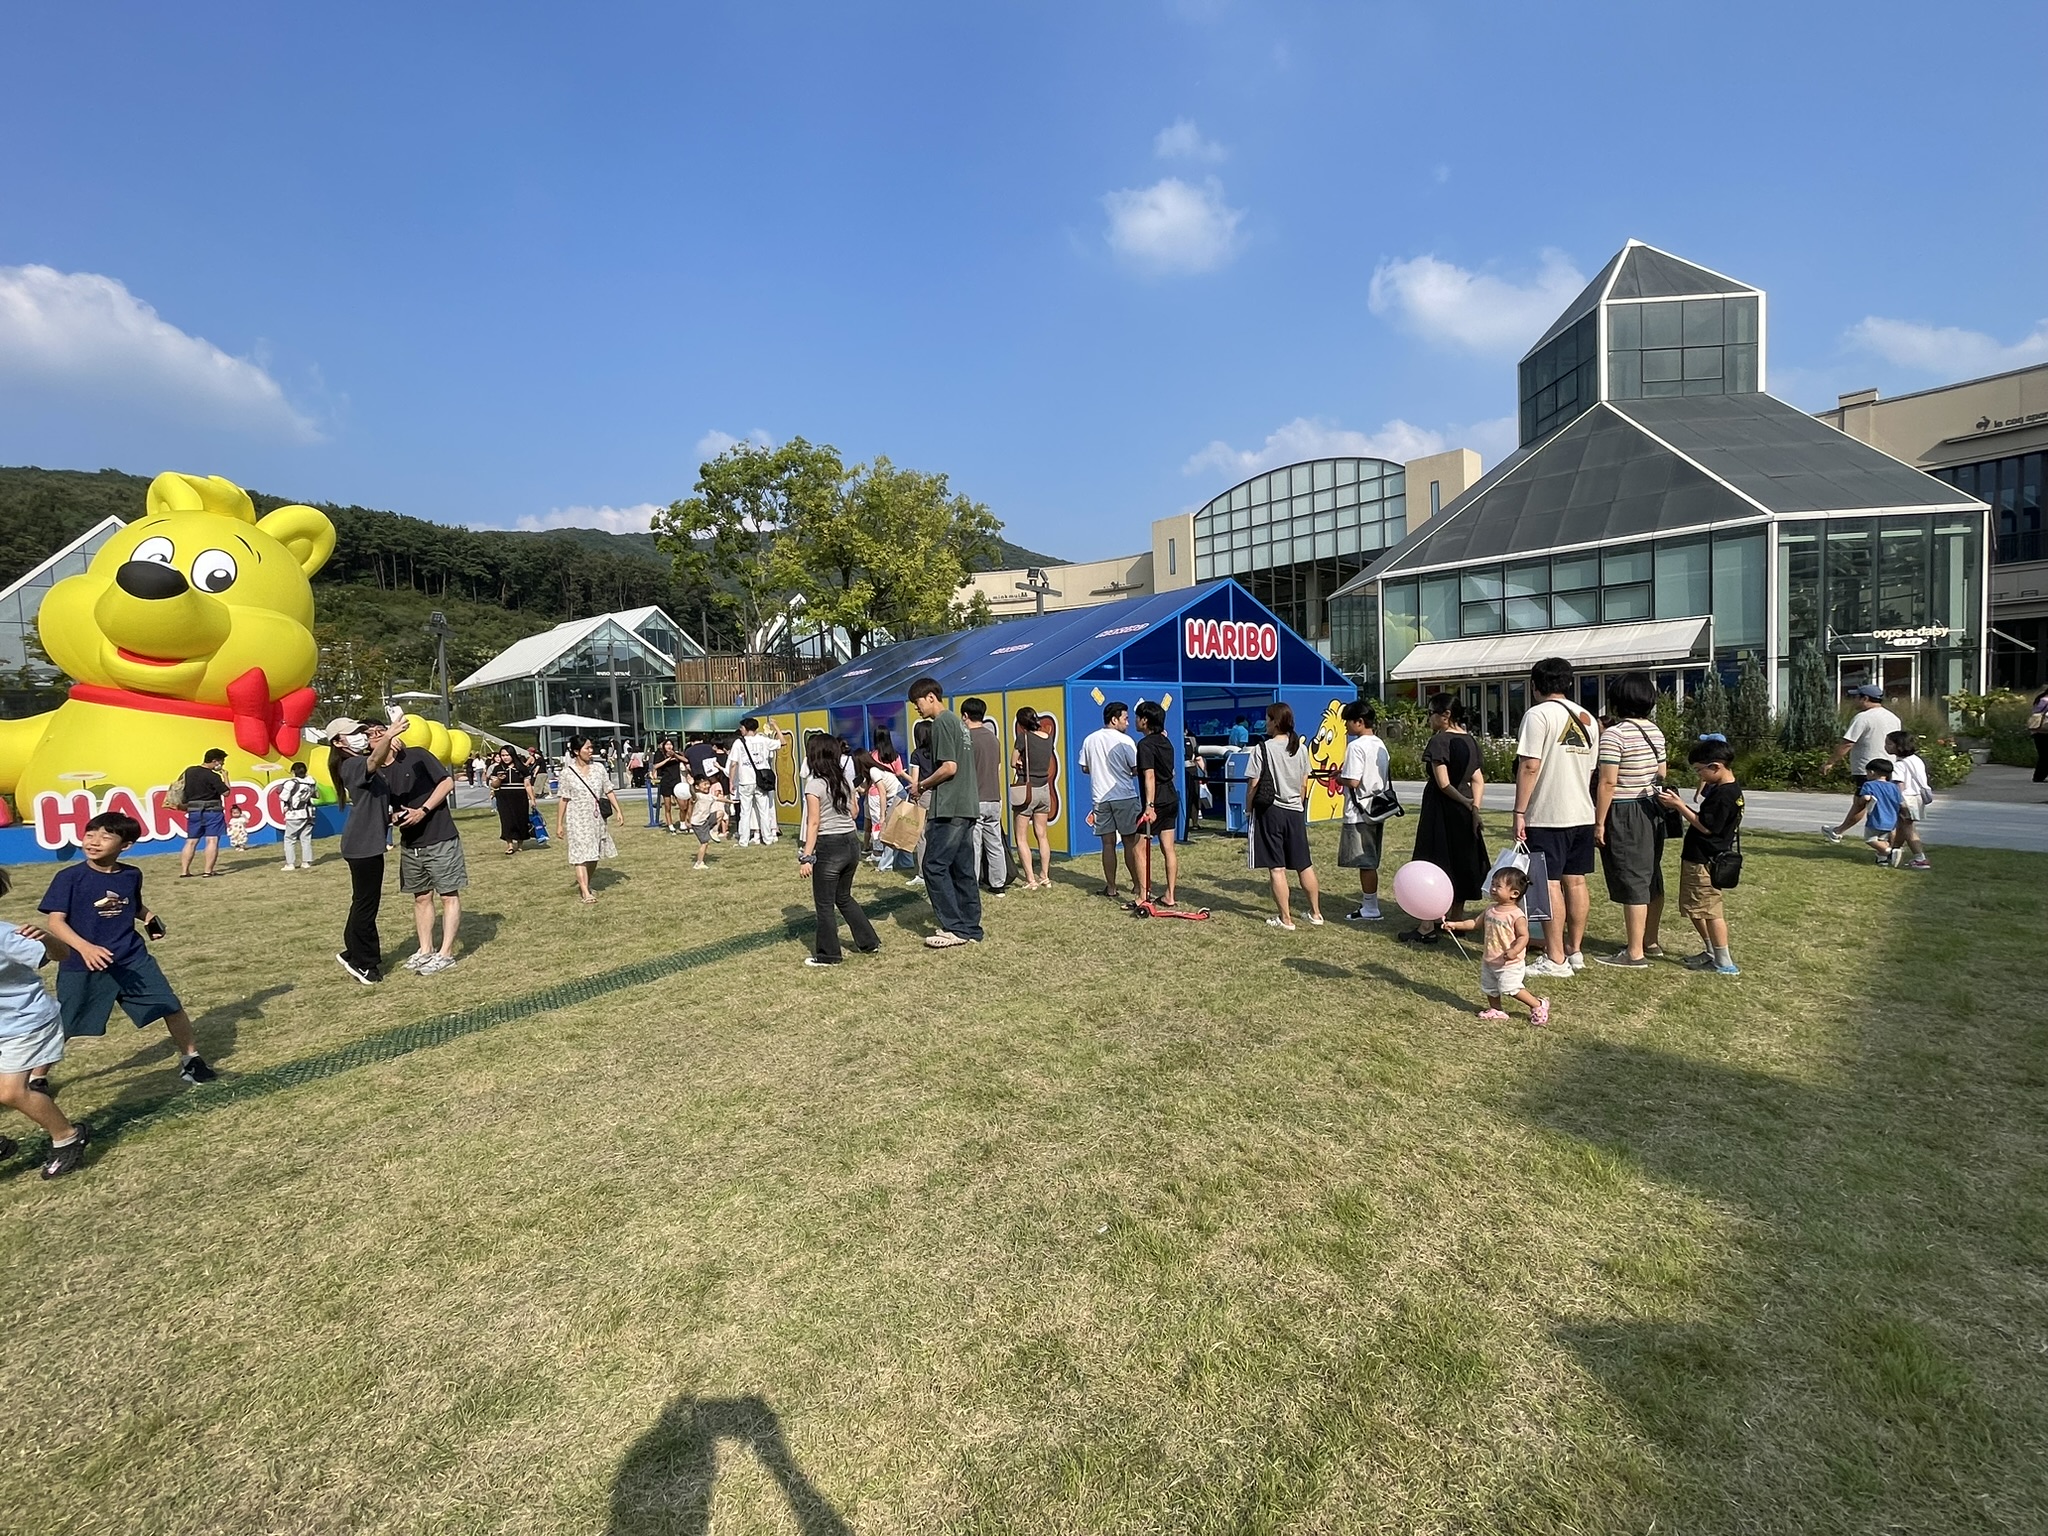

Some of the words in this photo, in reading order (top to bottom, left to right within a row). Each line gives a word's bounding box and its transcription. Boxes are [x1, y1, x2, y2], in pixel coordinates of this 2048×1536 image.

[2005, 416, 2024, 426] coq
[1185, 618, 1277, 661] HARIBO
[1872, 625, 1949, 640] oops-a-daisy
